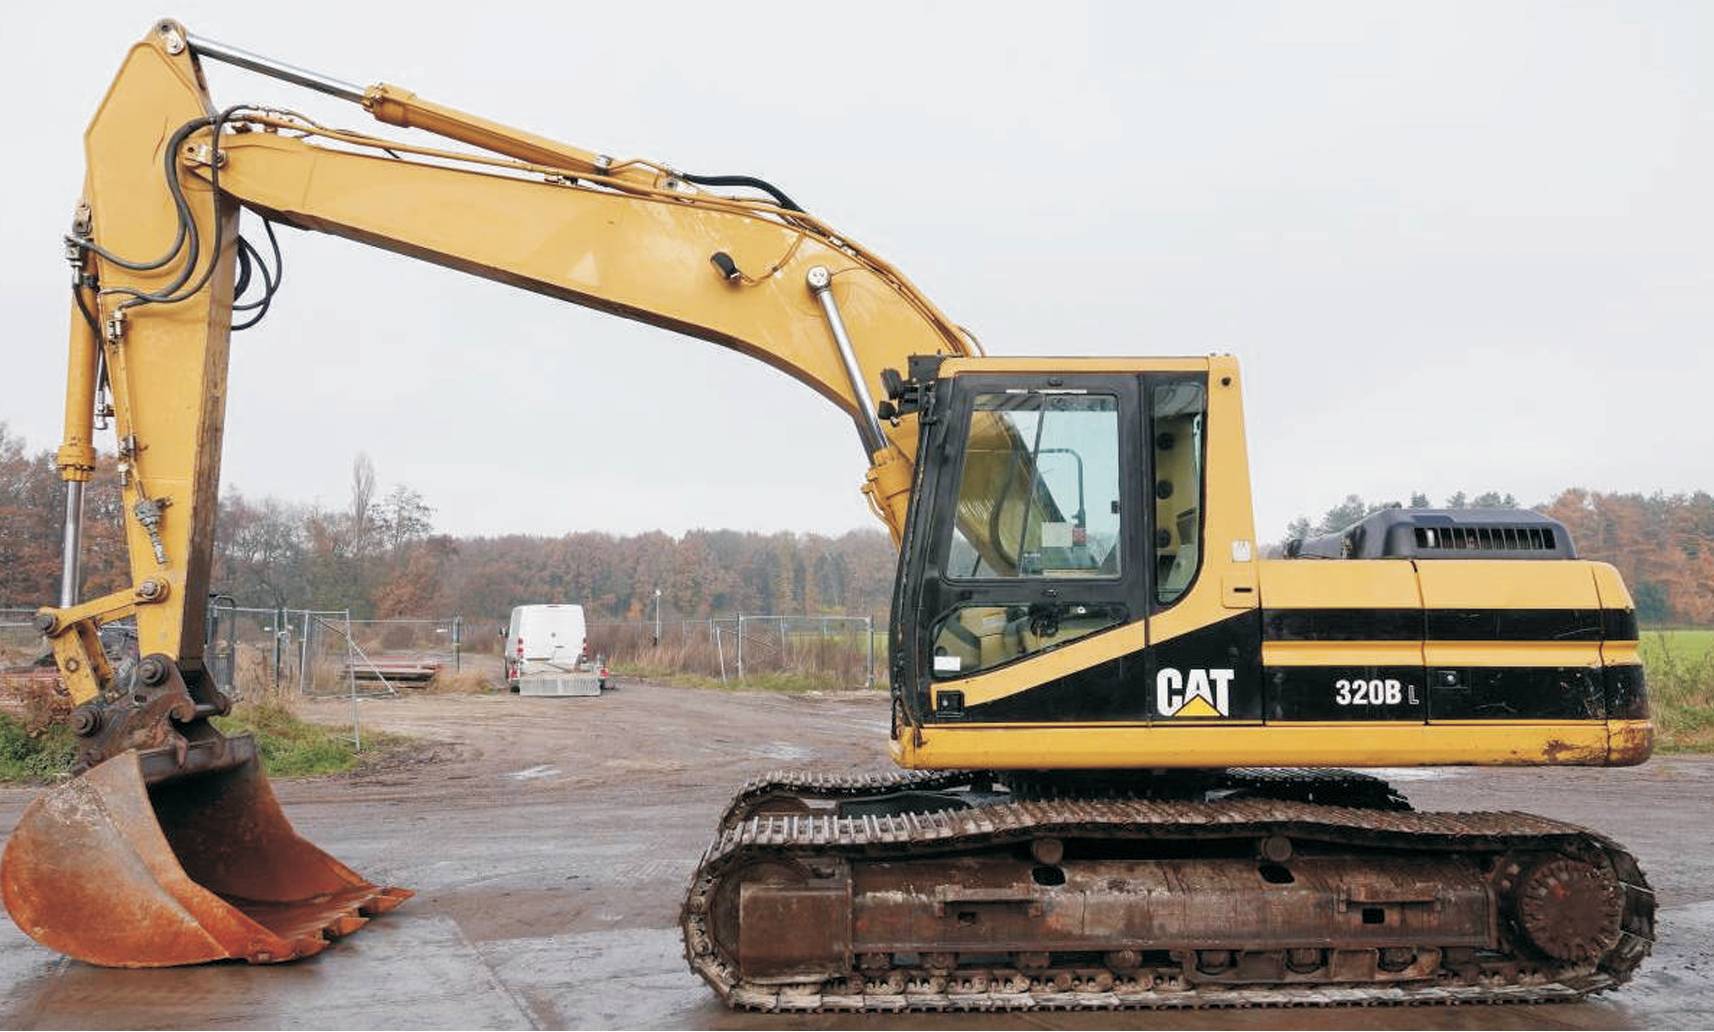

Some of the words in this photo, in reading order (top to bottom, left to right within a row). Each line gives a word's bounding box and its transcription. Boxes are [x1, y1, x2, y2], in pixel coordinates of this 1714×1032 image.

[1156, 667, 1234, 717] CAT
[1336, 679, 1401, 705] 320B
[1408, 684, 1419, 705] L
